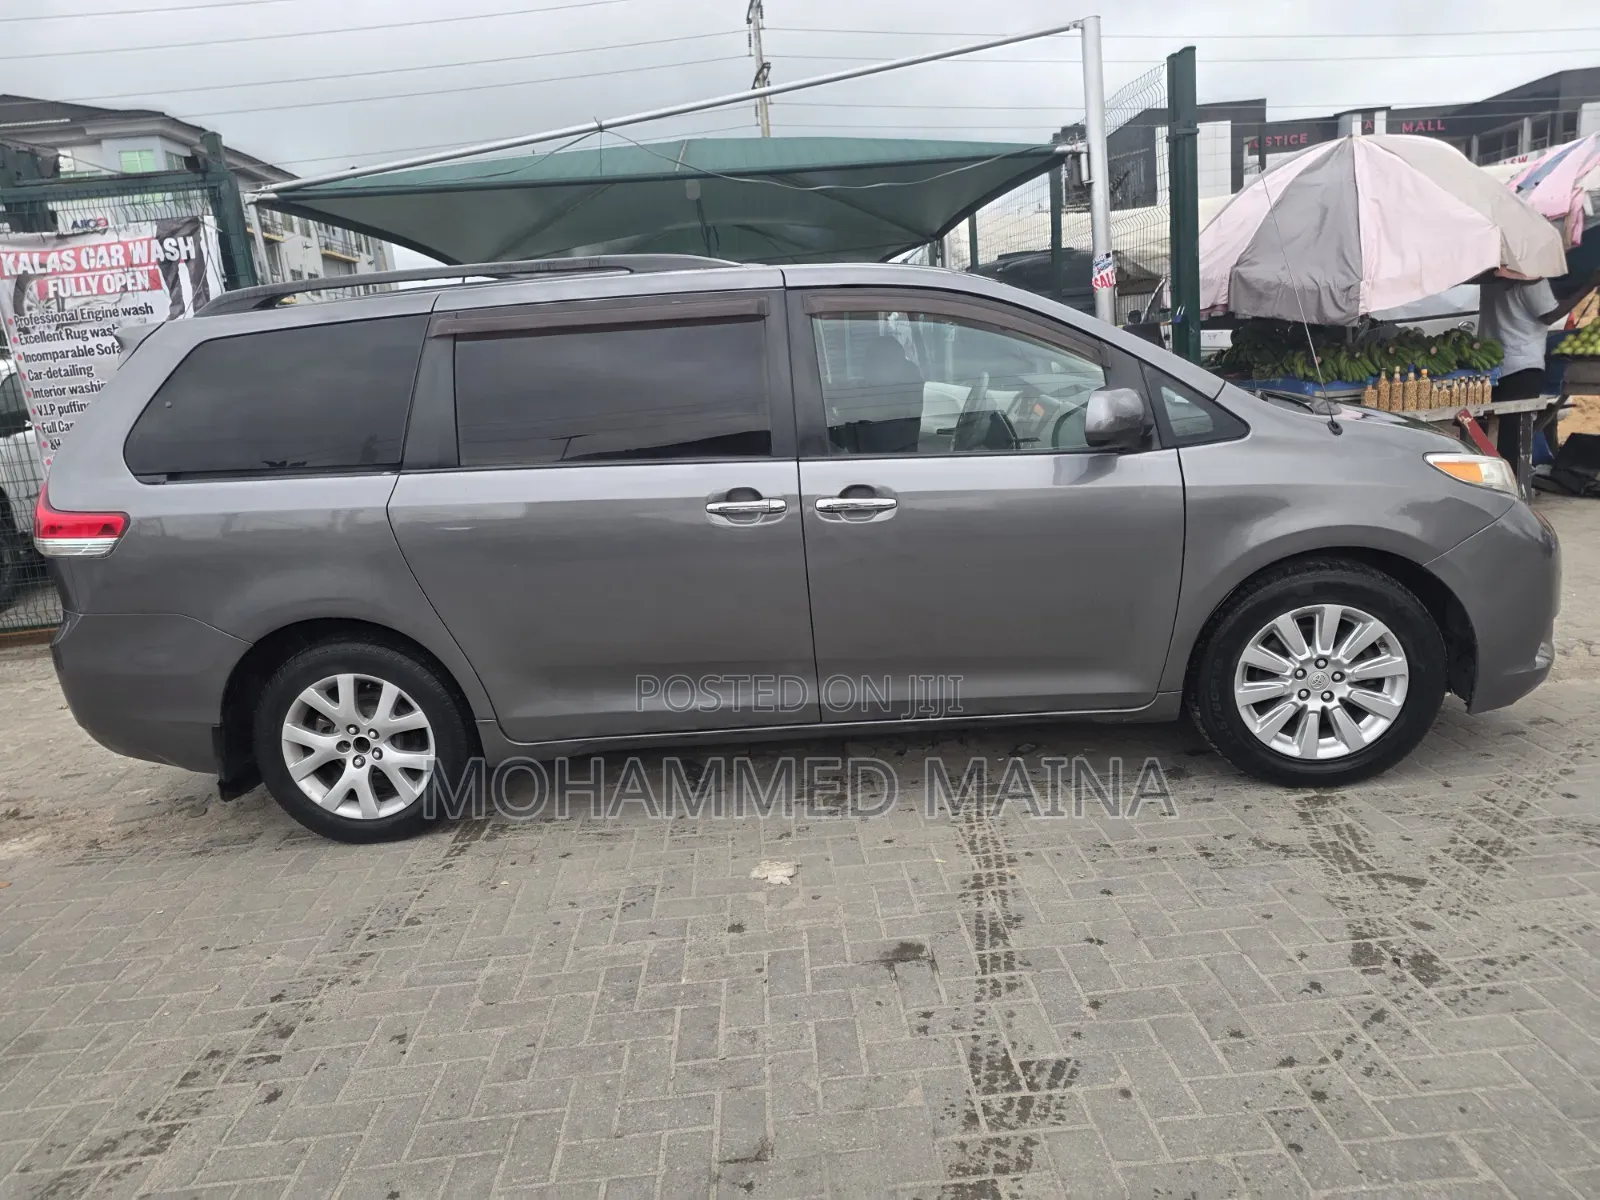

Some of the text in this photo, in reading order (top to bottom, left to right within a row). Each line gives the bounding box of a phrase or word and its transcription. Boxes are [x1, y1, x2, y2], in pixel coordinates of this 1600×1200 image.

[1402, 120, 1446, 133] MALL
[1, 235, 196, 277] KALAS CAR WASH
[47, 268, 150, 299] FULLY OPEN
[14, 302, 154, 327] Professional Engine wash
[20, 328, 64, 346] Excellent
[65, 328, 90, 342] Rug
[23, 344, 95, 364] Incomparable
[27, 365, 95, 382] Car-detailing
[31, 384, 67, 400] Interior
[58, 400, 90, 418] puffin
[41, 421, 57, 435] Full
